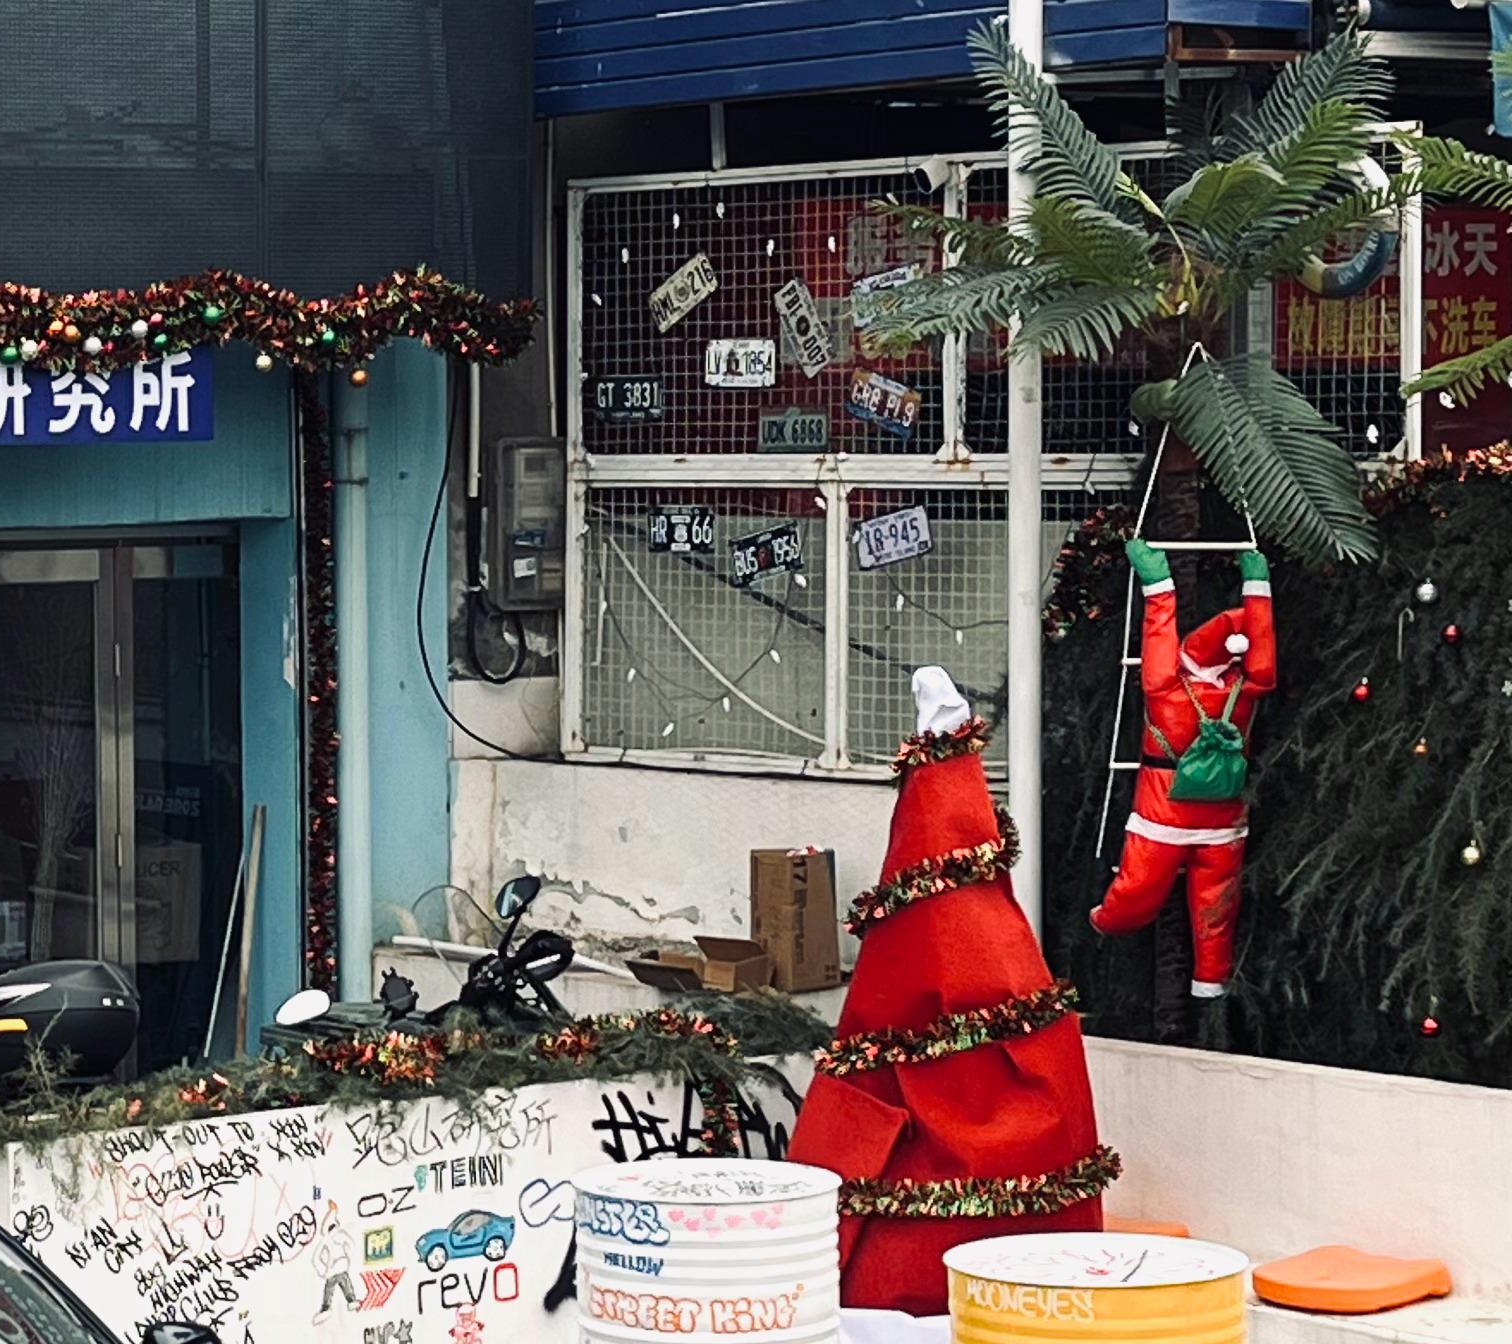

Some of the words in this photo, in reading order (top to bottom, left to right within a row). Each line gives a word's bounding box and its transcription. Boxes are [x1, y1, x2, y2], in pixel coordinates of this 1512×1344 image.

[803, 336, 828, 367] 007
[597, 382, 615, 407] GT
[623, 382, 659, 407] 3831
[691, 515, 714, 544] 66
[429, 1153, 503, 1194] TEIN
[418, 1262, 519, 1315] revo
[591, 1285, 701, 1333] STREET
